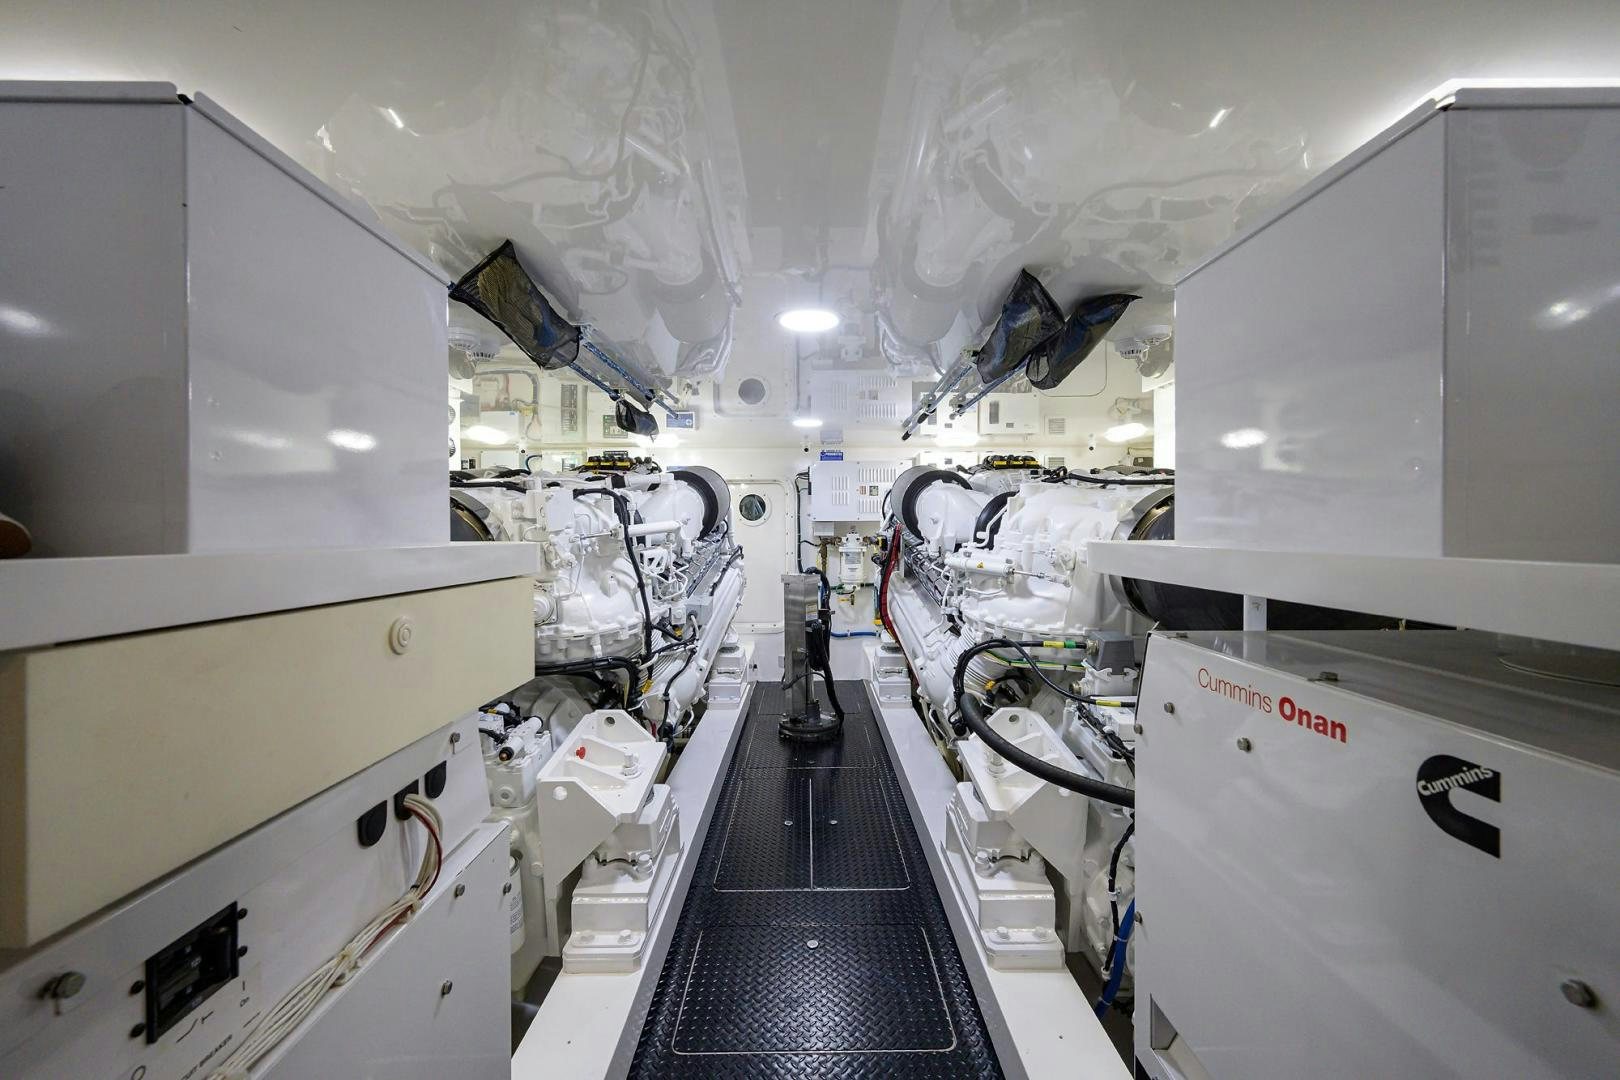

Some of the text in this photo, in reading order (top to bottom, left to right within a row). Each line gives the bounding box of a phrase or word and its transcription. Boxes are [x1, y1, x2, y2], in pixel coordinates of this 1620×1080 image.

[1198, 668, 1347, 744] Cummins Onan
[1417, 766, 1494, 796] Cummins
[199, 1034, 233, 1068] BREAKER
